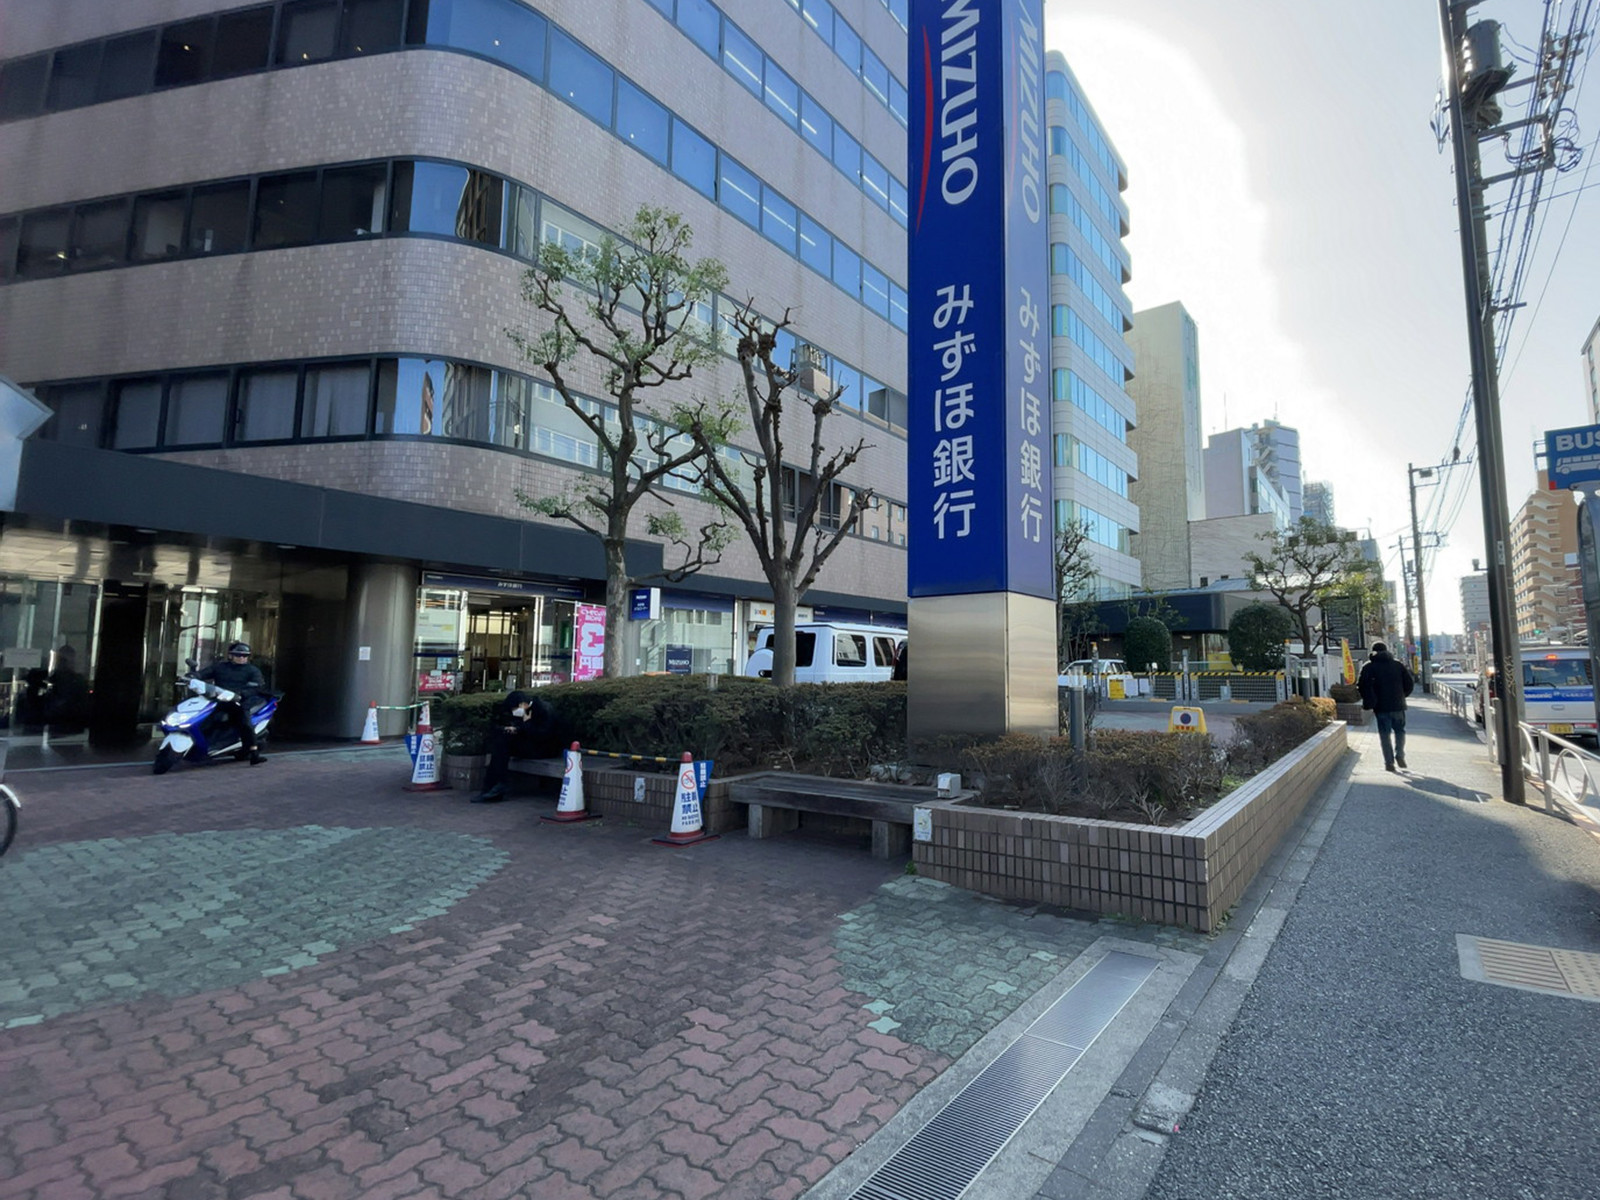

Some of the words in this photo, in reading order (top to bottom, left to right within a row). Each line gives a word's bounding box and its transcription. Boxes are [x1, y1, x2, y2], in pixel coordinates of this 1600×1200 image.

[941, 0, 980, 205] MIZUHO
[1018, 0, 1040, 224] MIZUHO
[932, 284, 976, 539] みずほ銀行
[1018, 287, 1043, 543] みずほ銀行
